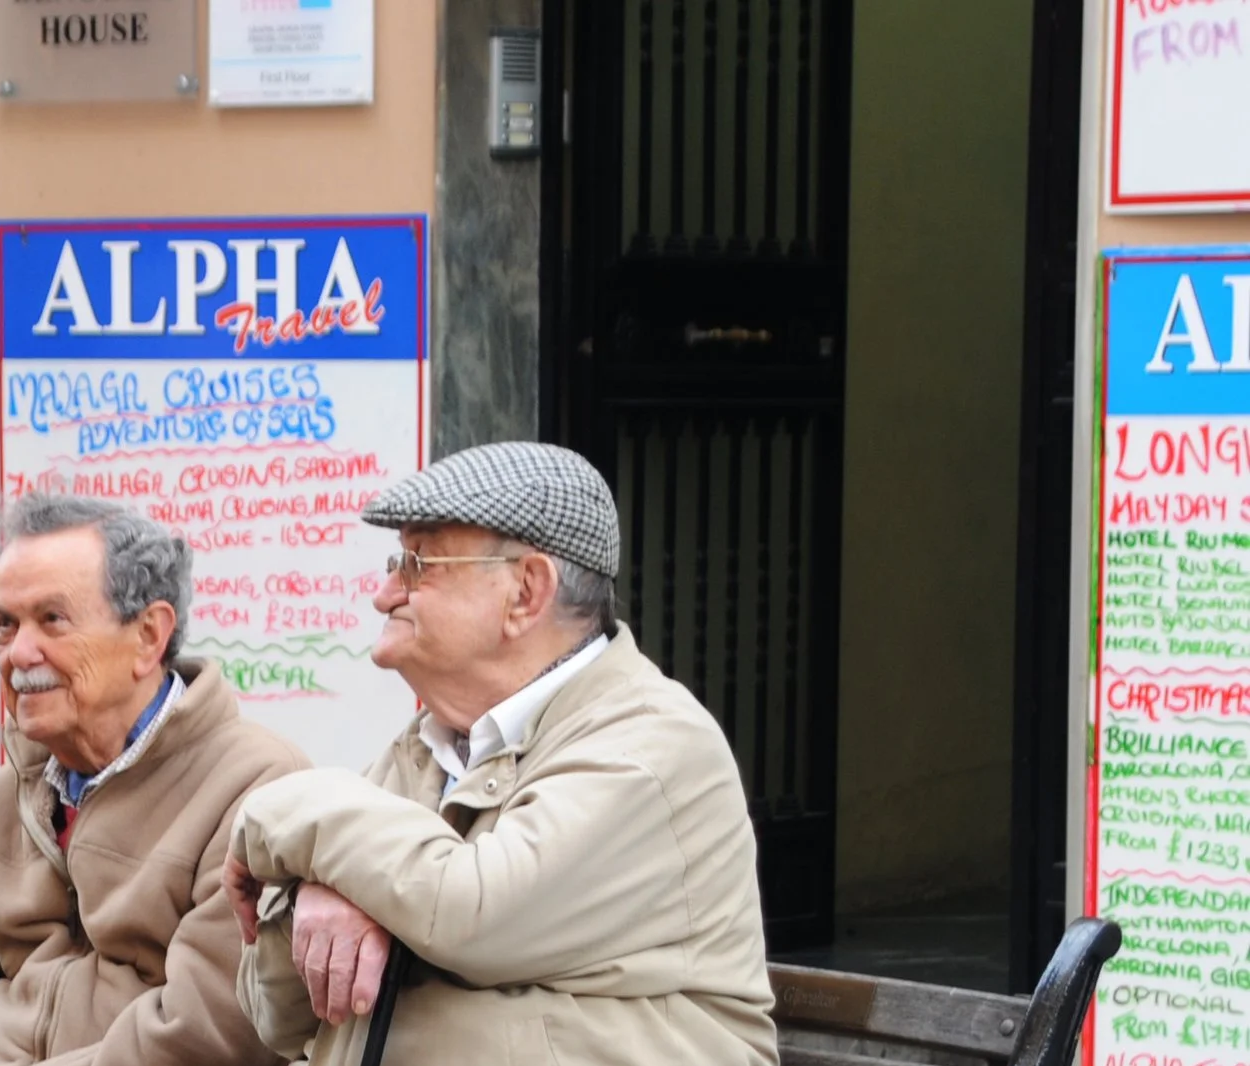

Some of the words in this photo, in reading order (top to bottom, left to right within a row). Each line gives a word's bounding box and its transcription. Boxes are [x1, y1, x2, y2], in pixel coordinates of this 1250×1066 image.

[40, 12, 148, 46] HOUSE
[1131, 16, 1243, 75] FROM
[32, 236, 380, 336] ALPHA
[216, 277, 386, 354] Travel
[163, 363, 320, 409] CRUISES
[78, 410, 226, 455] ADVENTURE
[1108, 529, 1177, 550] HOTEL
[1107, 553, 1169, 572] HOTEL
[1104, 725, 1248, 759] BRILLIANCE
[1103, 830, 1156, 850] FROM
[1113, 984, 1244, 1016] OPTIONAL
